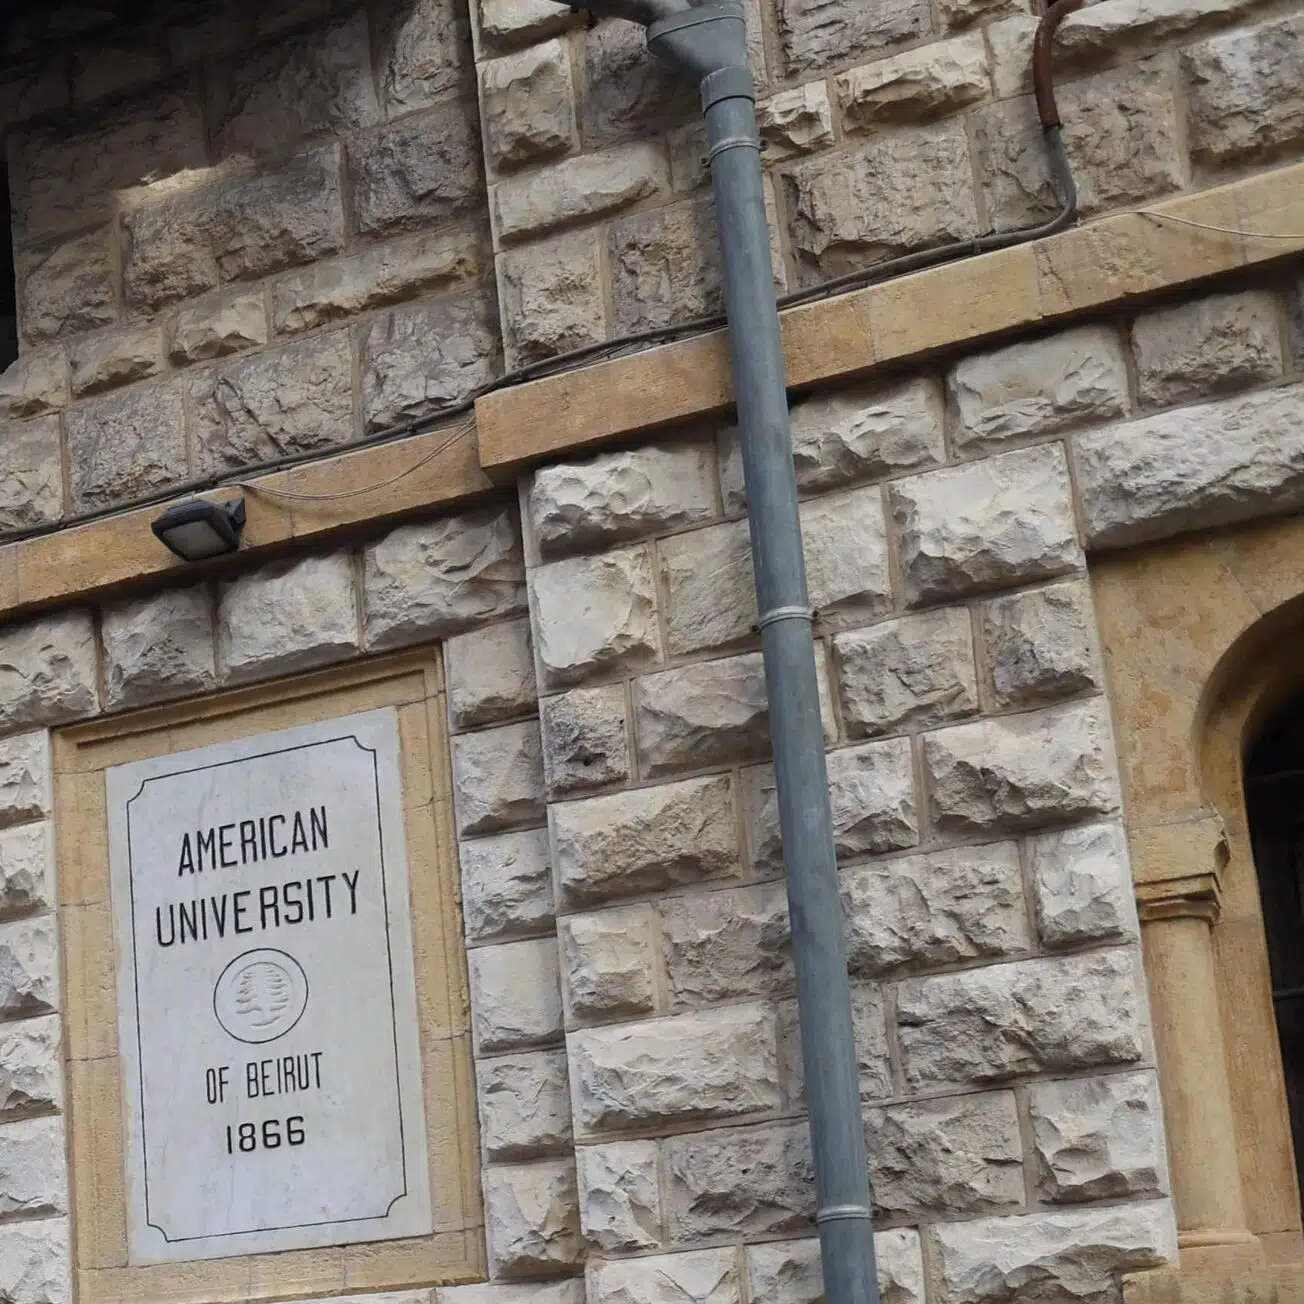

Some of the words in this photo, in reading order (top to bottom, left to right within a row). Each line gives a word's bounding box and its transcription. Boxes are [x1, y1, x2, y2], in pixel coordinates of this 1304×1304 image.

[177, 806, 329, 877] AMERICAN
[156, 870, 360, 948] UNIVERSITY
[206, 1066, 230, 1104] OF
[247, 1052, 323, 1100] BEIRUT
[226, 1115, 306, 1154] 1866
